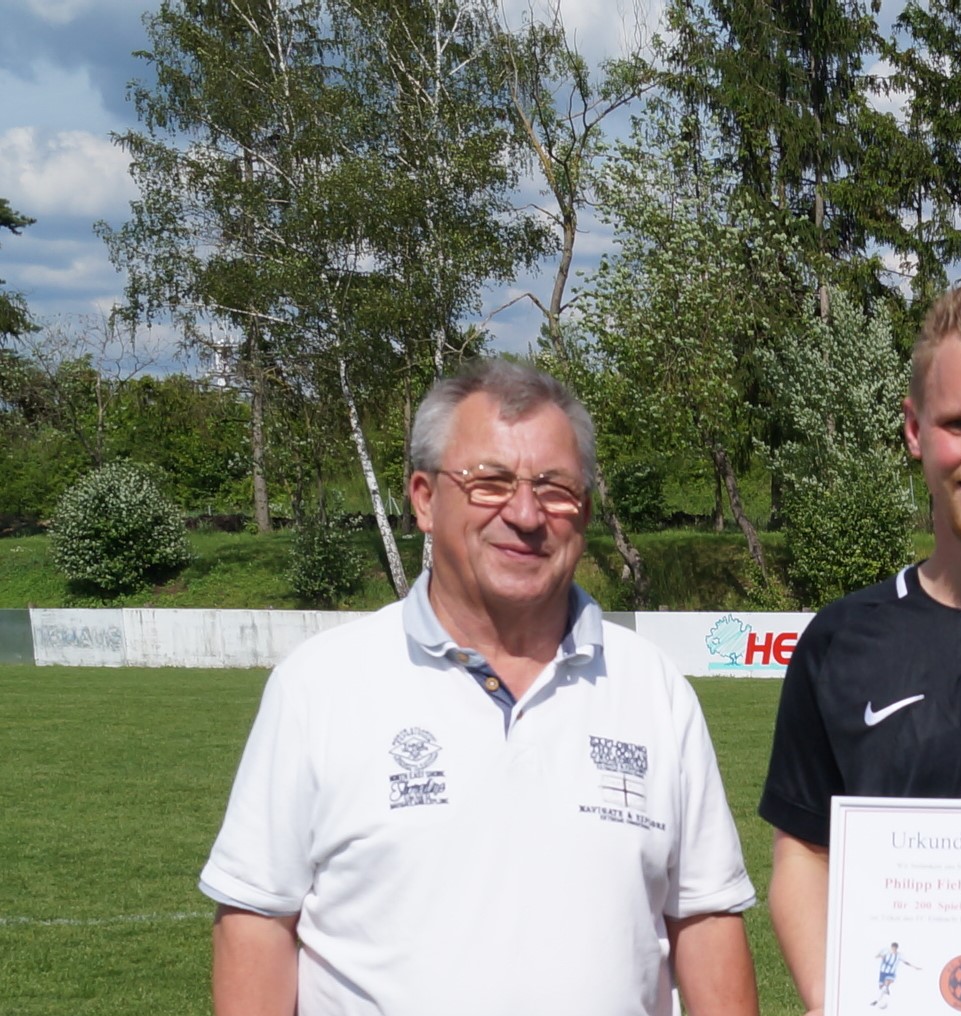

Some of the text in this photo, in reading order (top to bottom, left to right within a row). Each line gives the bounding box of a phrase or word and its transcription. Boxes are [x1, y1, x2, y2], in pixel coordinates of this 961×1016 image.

[884, 877, 932, 893] Philipp
[893, 900, 908, 909] für
[914, 901, 932, 910] 200
